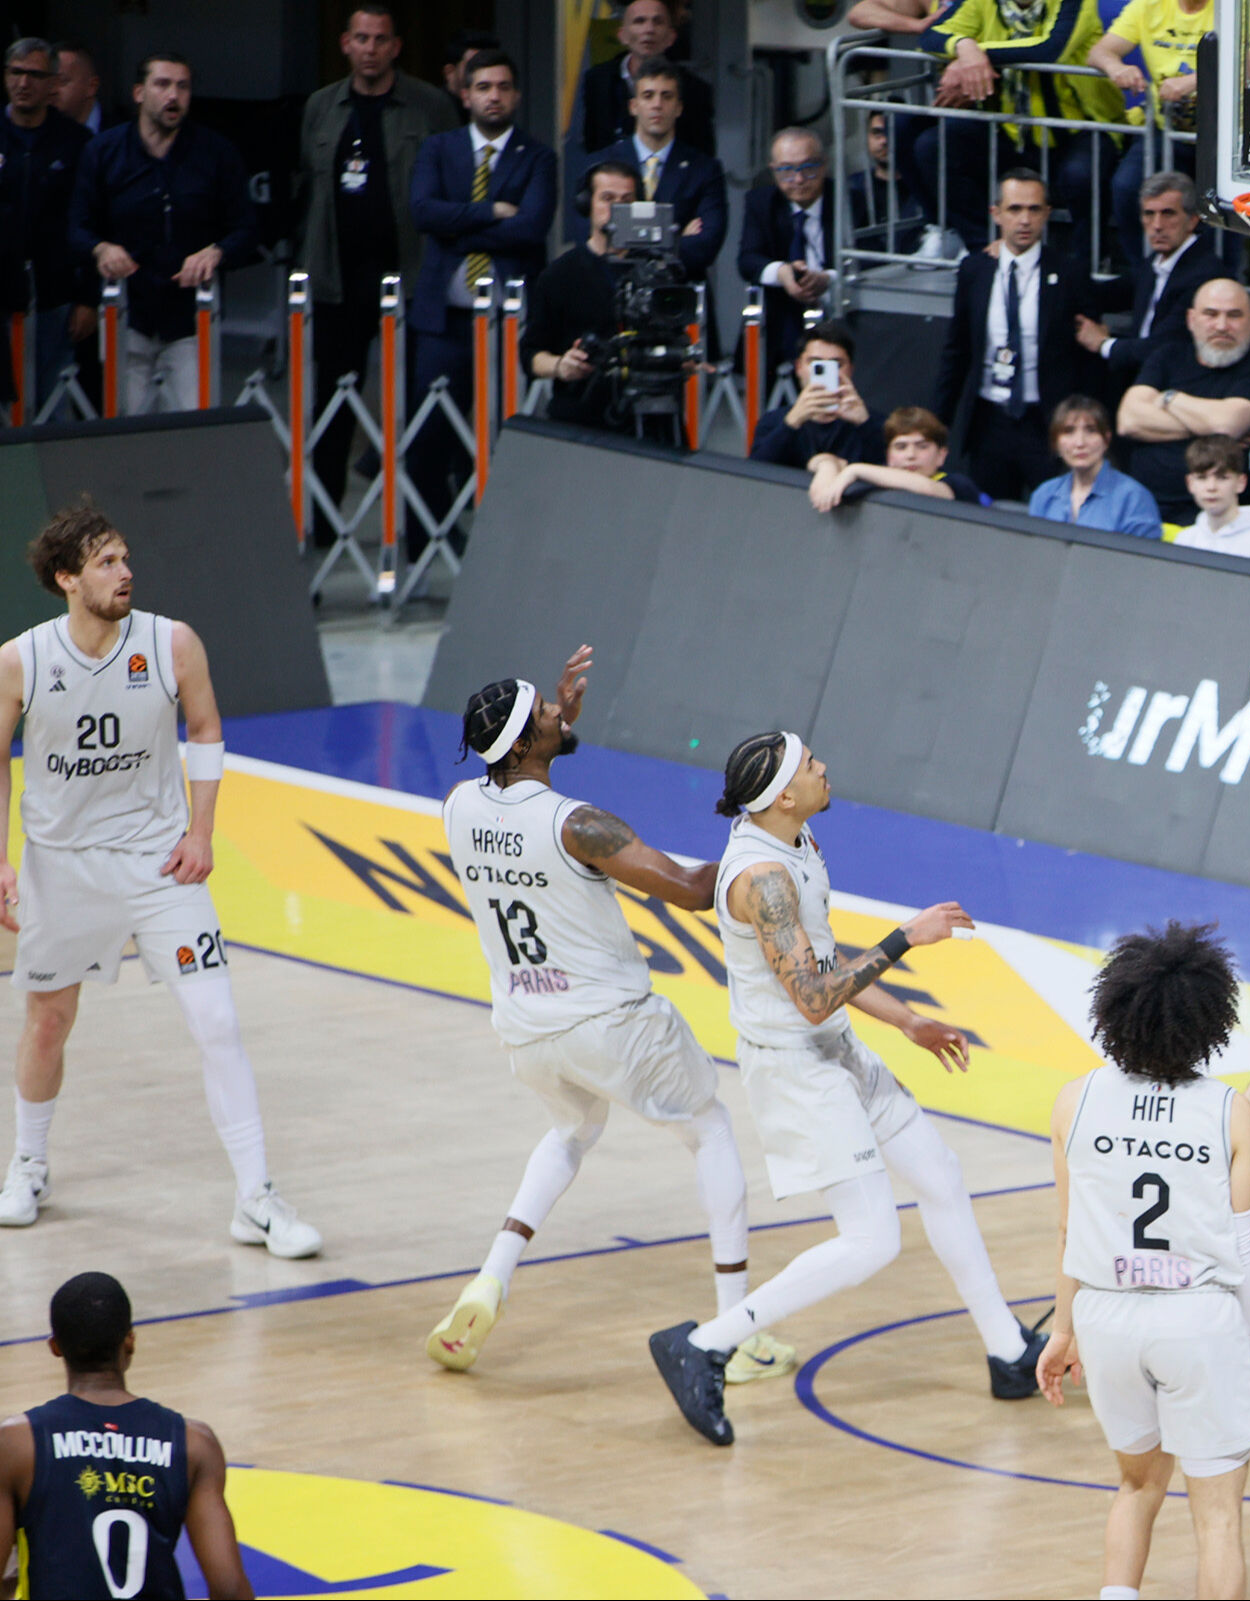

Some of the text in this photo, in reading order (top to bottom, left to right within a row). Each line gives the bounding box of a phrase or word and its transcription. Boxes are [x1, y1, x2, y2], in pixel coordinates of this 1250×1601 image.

[76, 712, 120, 750] 20
[472, 828, 524, 857] HAYES
[488, 898, 547, 965] 13
[1132, 1094, 1175, 1123] HIFI
[1094, 1135, 1210, 1164] O'TACOS
[1132, 1172, 1170, 1251] 2
[1114, 1255, 1192, 1288] PARIS
[52, 1430, 172, 1468] MCCOLLUM
[104, 1471, 155, 1497] MSC
[92, 1508, 149, 1600] 0
